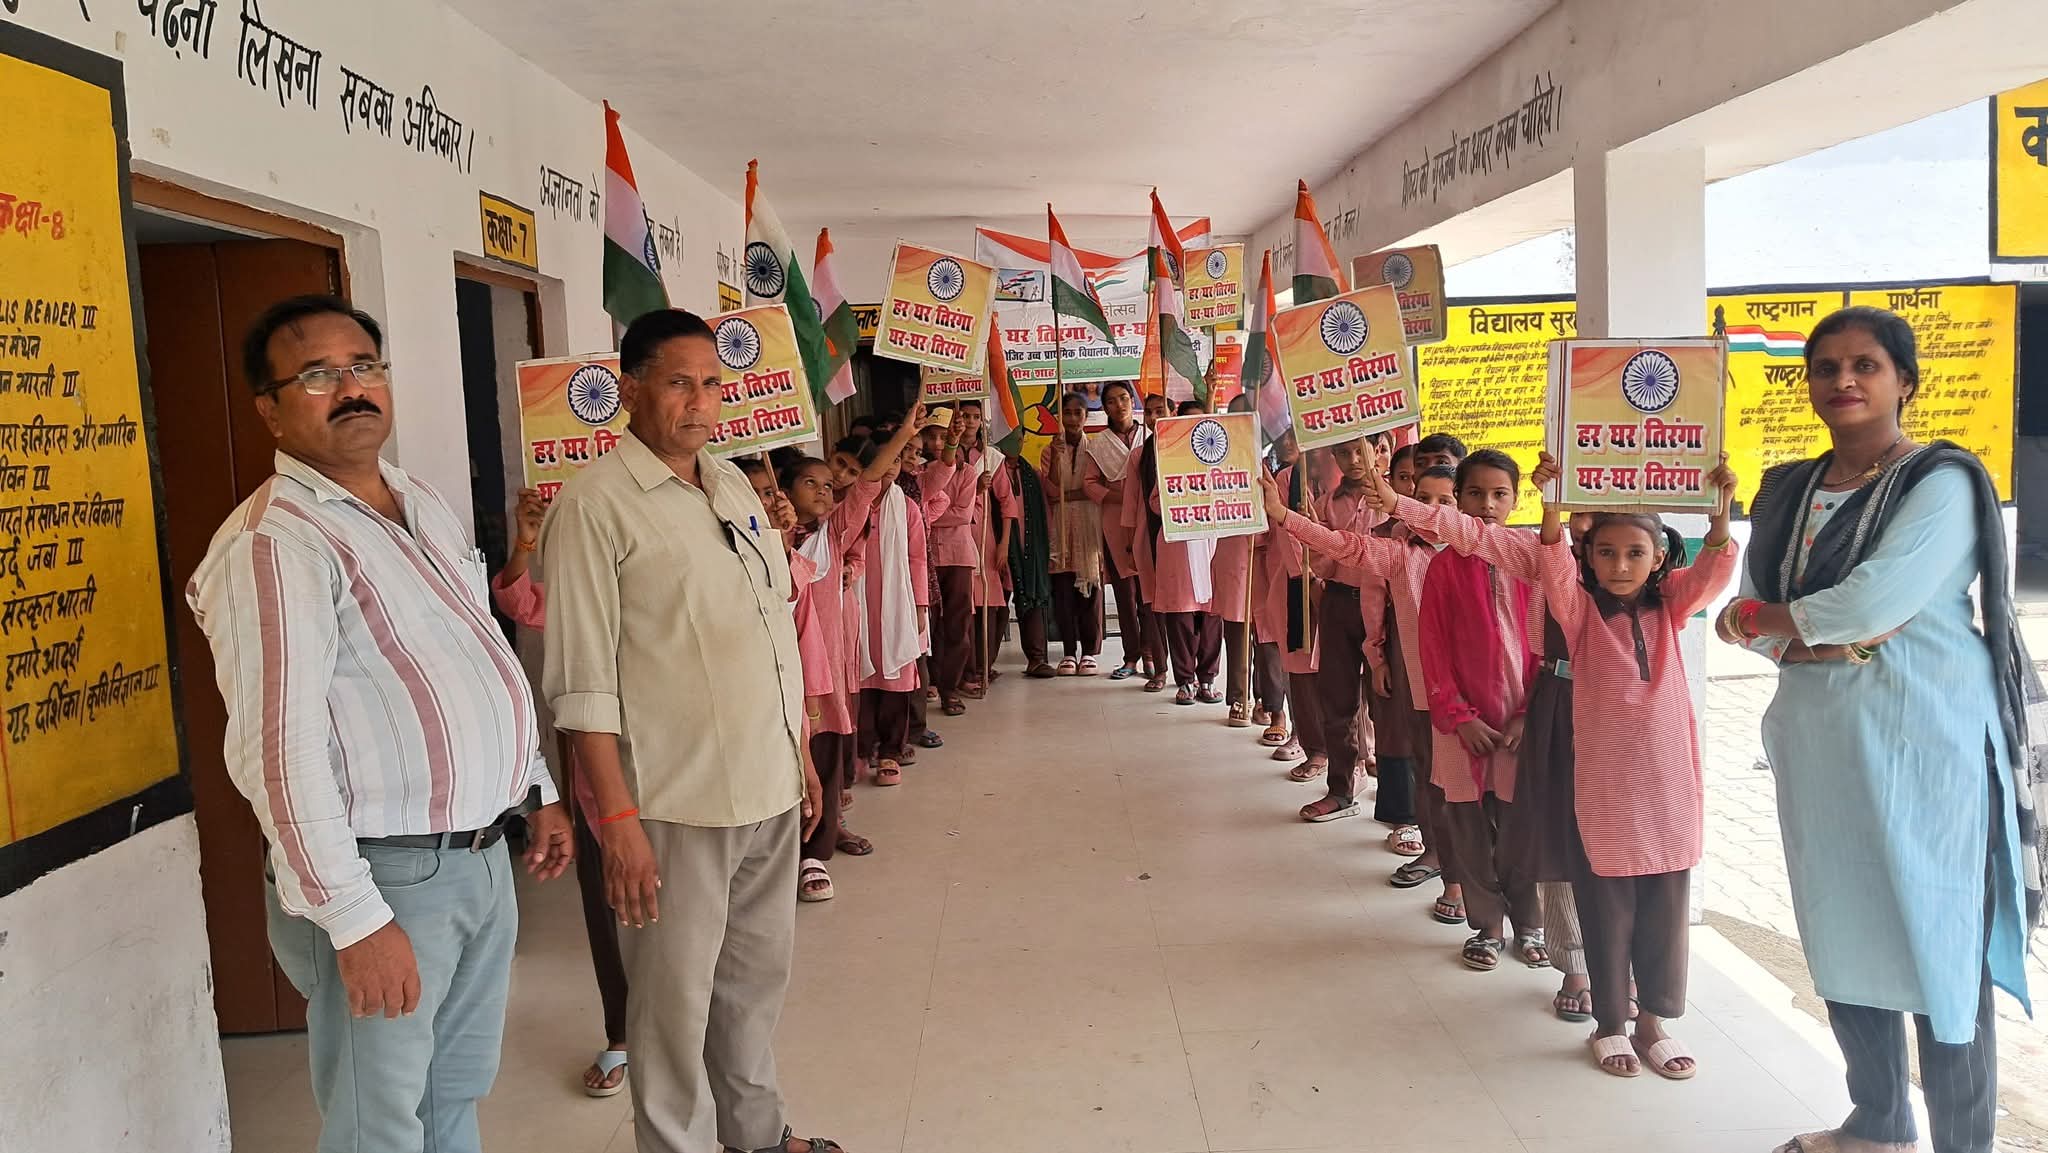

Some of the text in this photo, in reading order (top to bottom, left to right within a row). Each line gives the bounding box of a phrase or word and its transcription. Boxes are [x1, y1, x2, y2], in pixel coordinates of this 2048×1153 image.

[238, 0, 323, 110] लिखना
[341, 65, 394, 138] सबका
[485, 208, 529, 259] कक्षा-7
[24, 298, 77, 329] READER
[1746, 300, 1817, 322] राष्ट्रगान
[1887, 288, 1942, 310] प्रार्थना
[892, 299, 974, 332] हर घर तिरंगा
[1468, 308, 1545, 335] विद्यालय
[888, 328, 968, 360] घर-घर तिरंगा
[1079, 345, 1110, 358] विद्यालय
[743, 367, 794, 399] तिरंगा
[956, 376, 983, 393] तिरंगा
[1293, 374, 1317, 398] हर
[1319, 367, 1345, 390] घर
[1348, 352, 1399, 384] तिरंगा
[753, 403, 803, 437] तिरंगा
[1301, 388, 1405, 431] घर-घर तिरंगा
[21, 414, 68, 458] इतिहास
[73, 414, 97, 453] और
[98, 414, 137, 448] नागरिक
[1576, 417, 1704, 449] हर घर तिरंगा
[532, 440, 557, 464] हर
[561, 437, 589, 461] घर
[1165, 466, 1249, 493] हर घर तिरंगा
[1577, 461, 1702, 491] घर-घर तिरंगा
[1169, 498, 1252, 524] घर-घर तिरंगा
[1, 574, 97, 635] संस्कृत भारती
[5, 625, 85, 691] हमारे आदर्श
[6, 703, 30, 744] गृह
